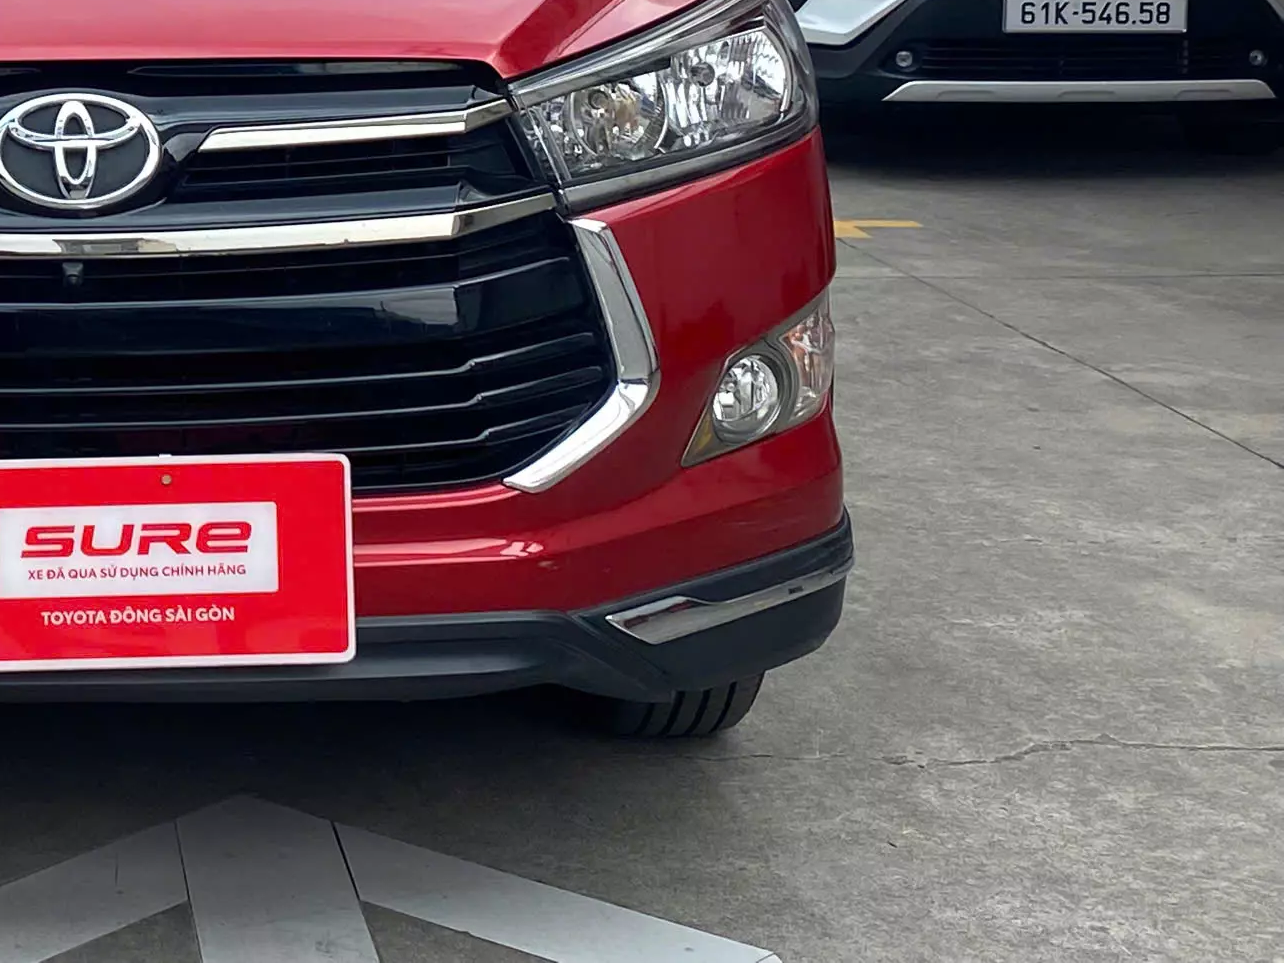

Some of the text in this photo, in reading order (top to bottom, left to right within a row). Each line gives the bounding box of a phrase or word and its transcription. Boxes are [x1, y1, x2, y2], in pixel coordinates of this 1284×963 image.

[1021, 1, 1171, 25] 61K-546.58
[28, 569, 43, 580] XE
[47, 566, 65, 580] ĐÃ
[68, 567, 97, 580] QUA
[100, 564, 117, 579] SỬ
[120, 566, 158, 581] DỤNG
[162, 564, 204, 578] CHÍNH
[41, 605, 235, 626] TOYOTA ĐÔNG SÀI GÒN
